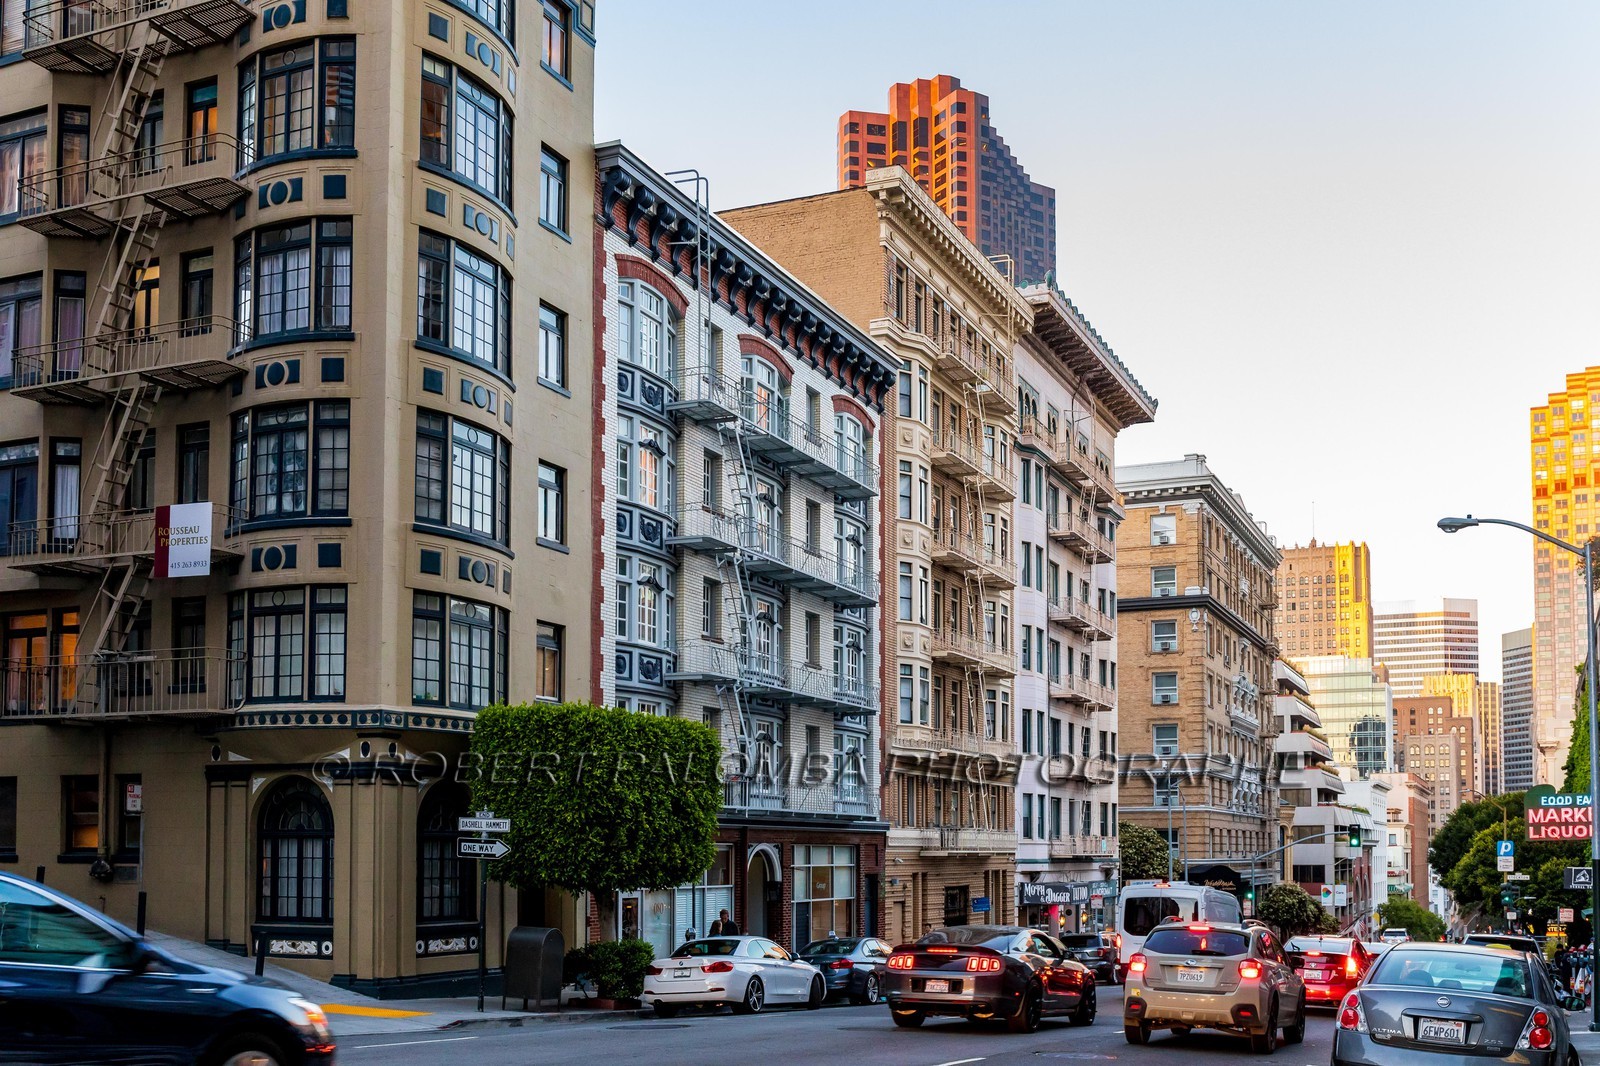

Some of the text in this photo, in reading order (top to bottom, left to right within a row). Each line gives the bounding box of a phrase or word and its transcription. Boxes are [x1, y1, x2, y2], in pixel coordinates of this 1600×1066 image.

[158, 526, 200, 536] ROUSSEAU
[160, 536, 208, 547] PROPERTIES
[182, 561, 192, 569] 263
[193, 560, 207, 568] 8933
[1541, 796, 1572, 806] FOOD
[461, 820, 507, 830] DASHIELL HAMMETT
[1024, 883, 1046, 897] MOTH
[1045, 888, 1071, 904] DAGGER
[1372, 1027, 1402, 1035] ALTIMA
[1423, 1025, 1460, 1039] 6FWP601
